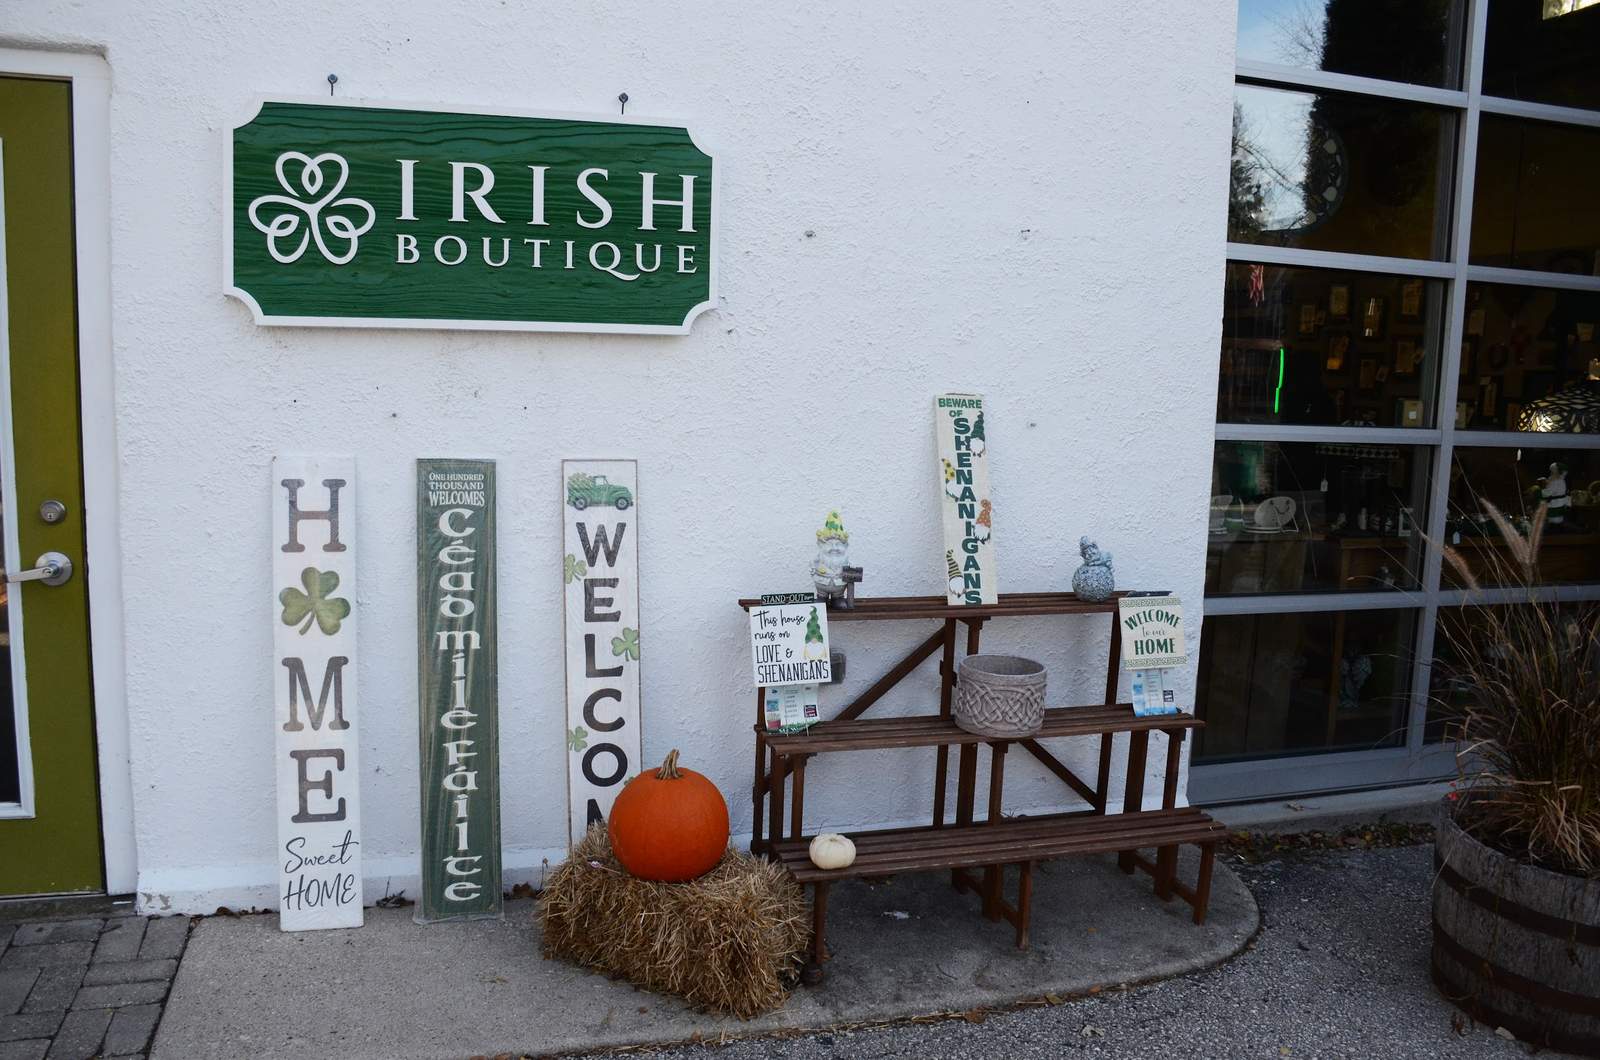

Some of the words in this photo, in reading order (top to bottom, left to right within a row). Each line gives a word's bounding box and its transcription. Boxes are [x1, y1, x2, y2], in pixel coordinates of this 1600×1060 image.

[395, 158, 699, 234] IRISH
[395, 233, 698, 281] BOUTIQUE
[938, 397, 982, 409] BEWARE
[948, 409, 963, 418] OF
[428, 481, 484, 491] THOUSAND
[429, 471, 445, 481] ONE
[446, 472, 485, 481] HUNDRED
[428, 490, 485, 507] WELCOMES
[953, 417, 982, 605] SHENANIGANS
[752, 609, 778, 630] This
[780, 608, 806, 626] house
[1124, 608, 1182, 630] WELCOME
[754, 631, 776, 641] runs
[779, 630, 791, 639] on
[755, 644, 782, 664] LOVE
[785, 648, 793, 659] &
[1134, 638, 1176, 655] HOME
[757, 660, 829, 684] SHENANIGANS
[284, 829, 360, 874] Sweet
[282, 872, 357, 911] HOME
